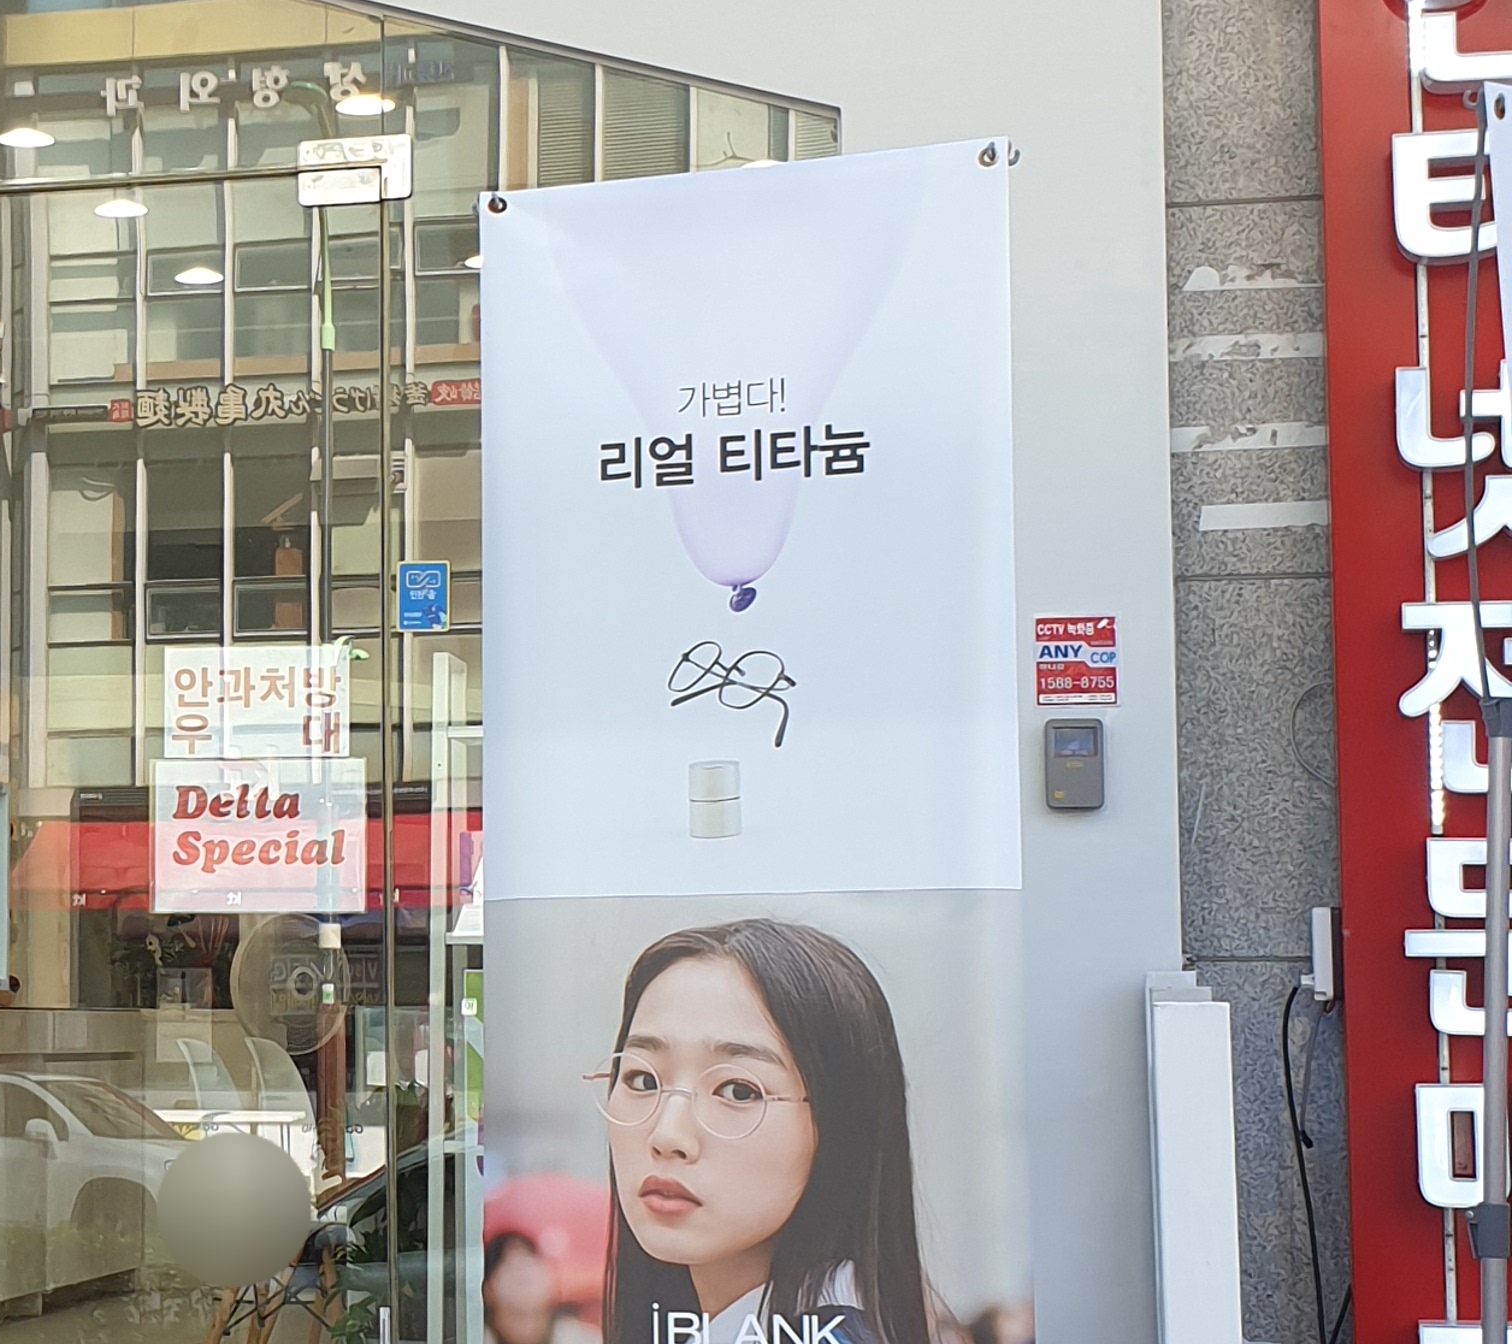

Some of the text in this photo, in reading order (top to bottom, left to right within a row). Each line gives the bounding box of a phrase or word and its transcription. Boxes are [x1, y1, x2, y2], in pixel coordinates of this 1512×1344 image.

[678, 377, 786, 418] 가볍다!
[600, 424, 871, 489] 리얼 티타늄
[1037, 623, 1065, 635] CCTV
[1039, 644, 1116, 664] ANY COP
[172, 666, 342, 709] 안과처방
[172, 783, 301, 820] Delta
[172, 828, 346, 874] Special
